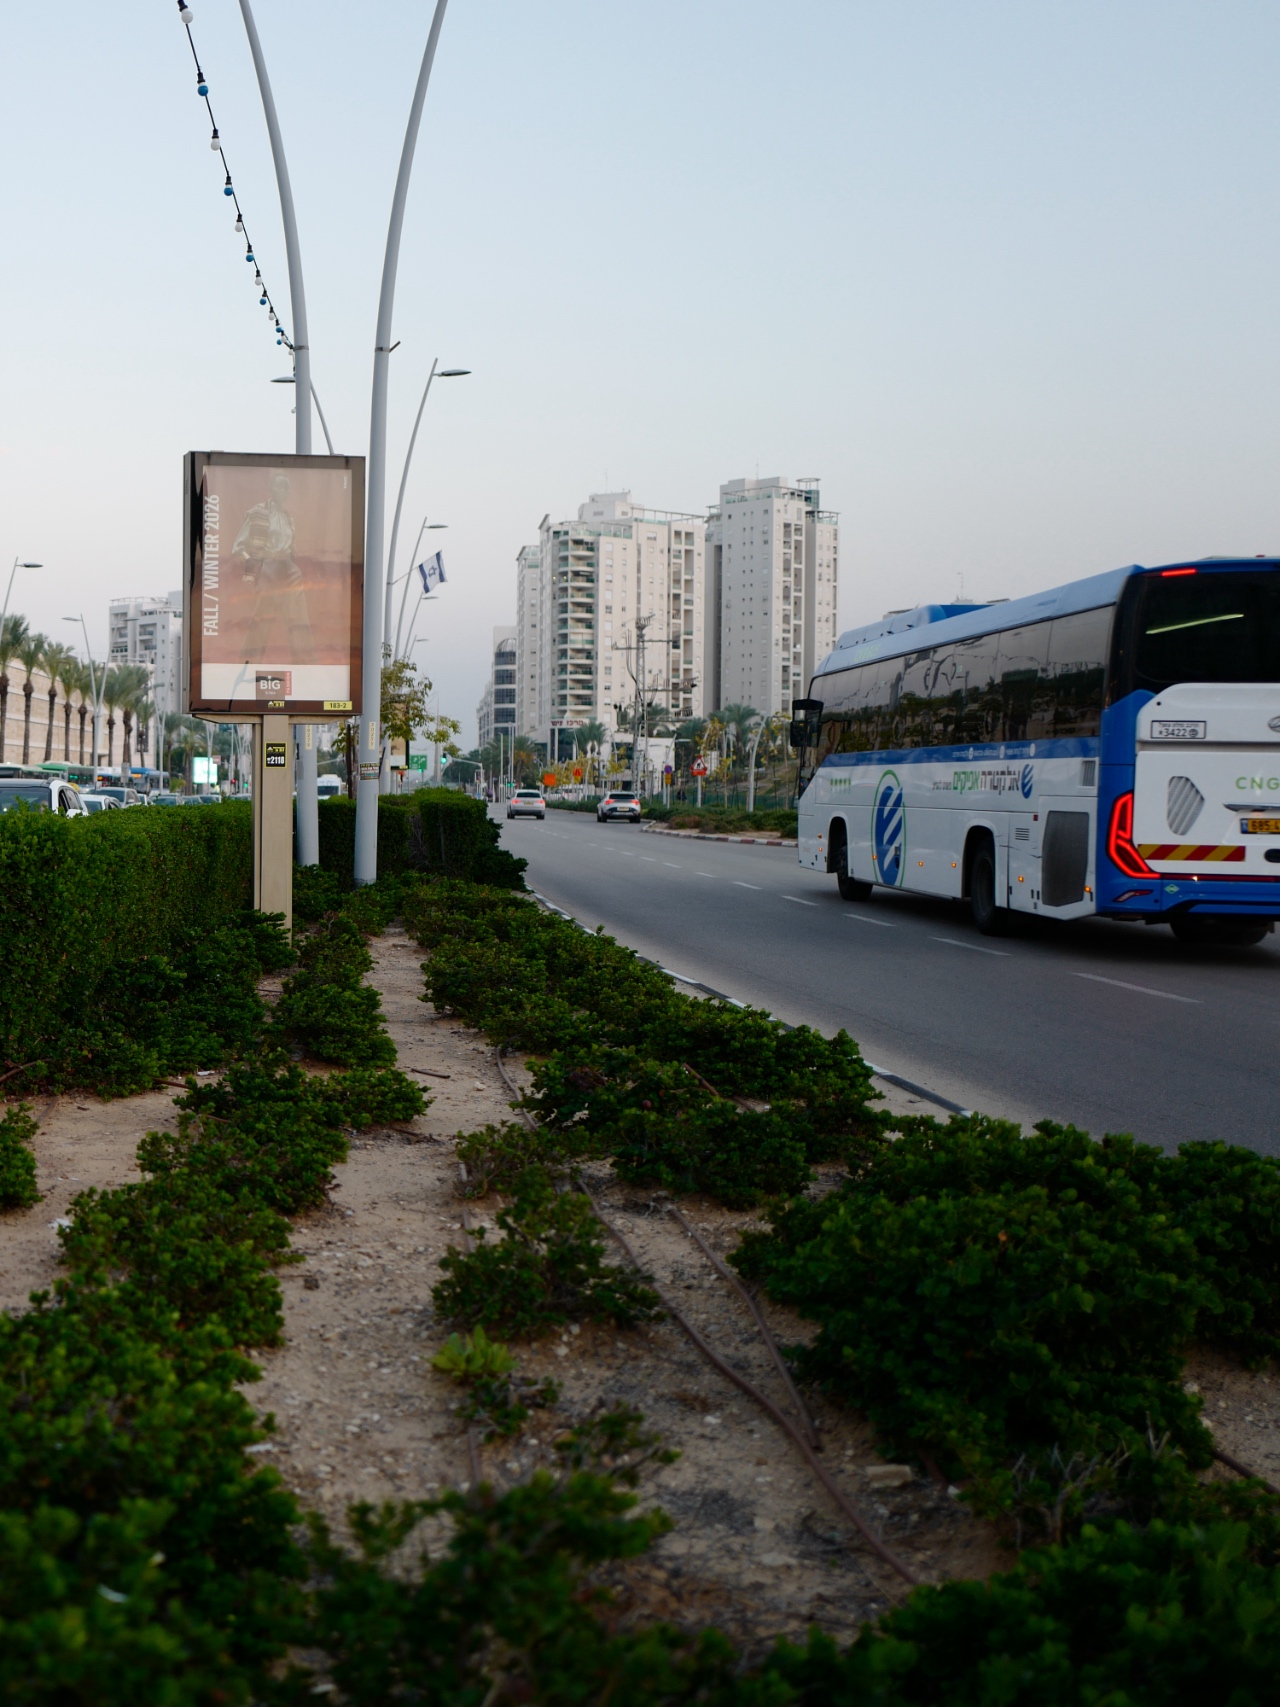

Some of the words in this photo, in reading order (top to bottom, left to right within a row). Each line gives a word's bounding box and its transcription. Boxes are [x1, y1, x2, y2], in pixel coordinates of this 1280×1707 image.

[204, 494, 220, 531] 2026
[203, 534, 219, 590] WINTER
[203, 604, 218, 636] FALL
[1234, 776, 1280, 791] CNG
